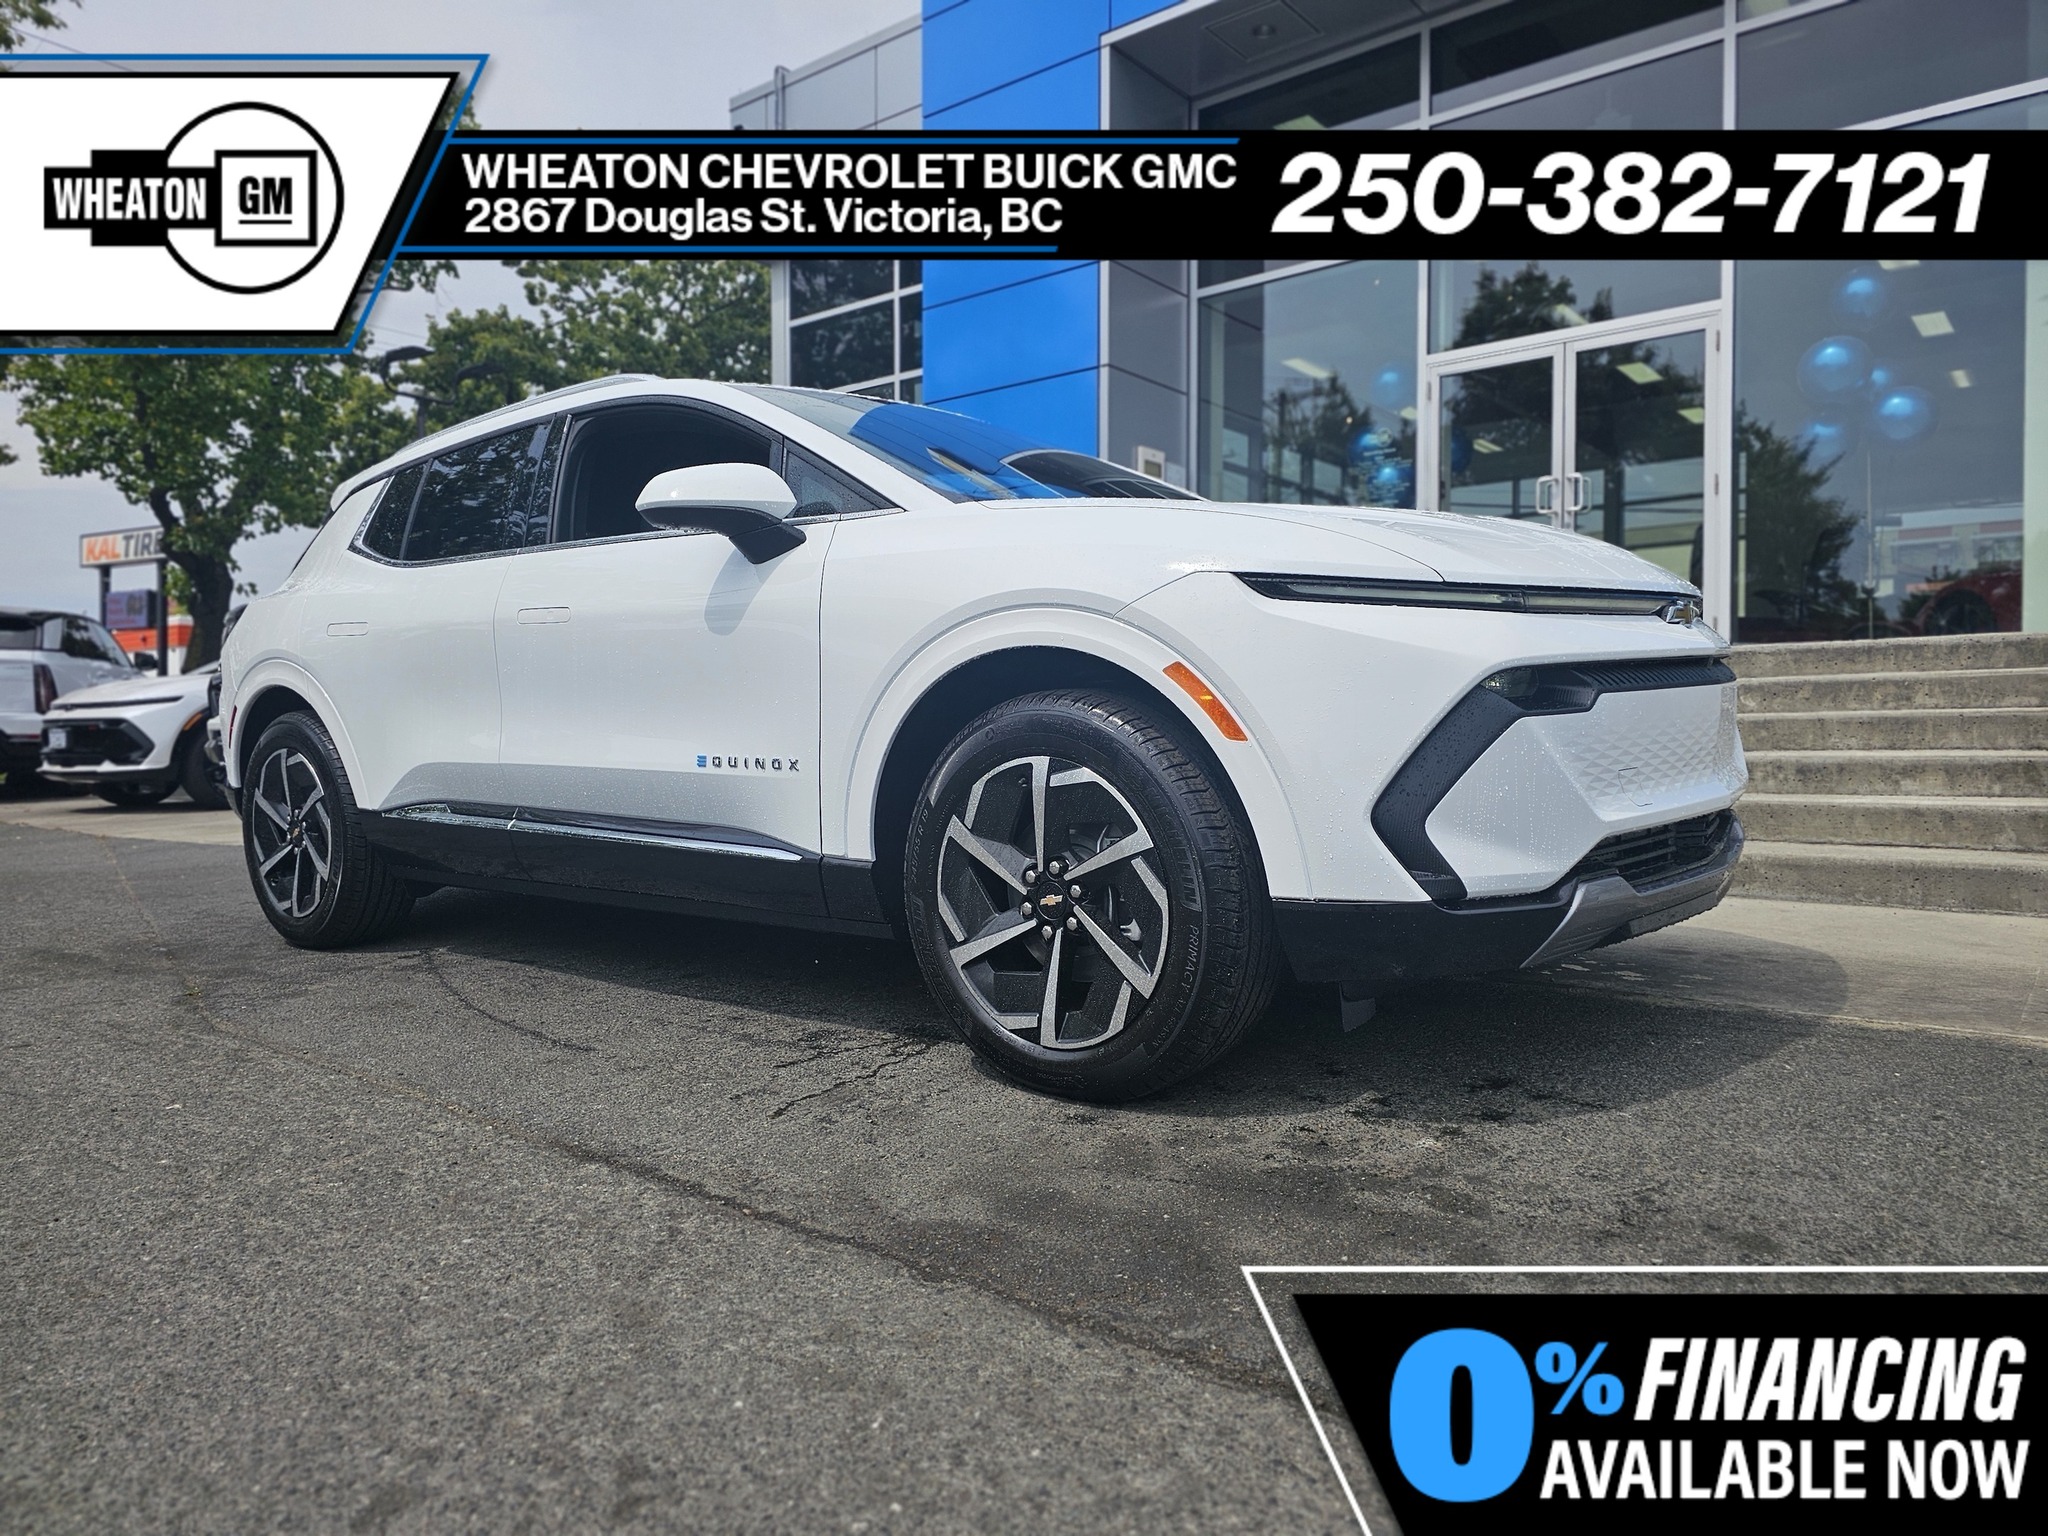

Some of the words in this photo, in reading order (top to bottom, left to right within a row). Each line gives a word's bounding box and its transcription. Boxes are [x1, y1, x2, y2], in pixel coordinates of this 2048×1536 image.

[85, 535, 121, 562] KAL
[696, 755, 800, 772] EQUINOX
[1180, 924, 1200, 994] PRIMACY
